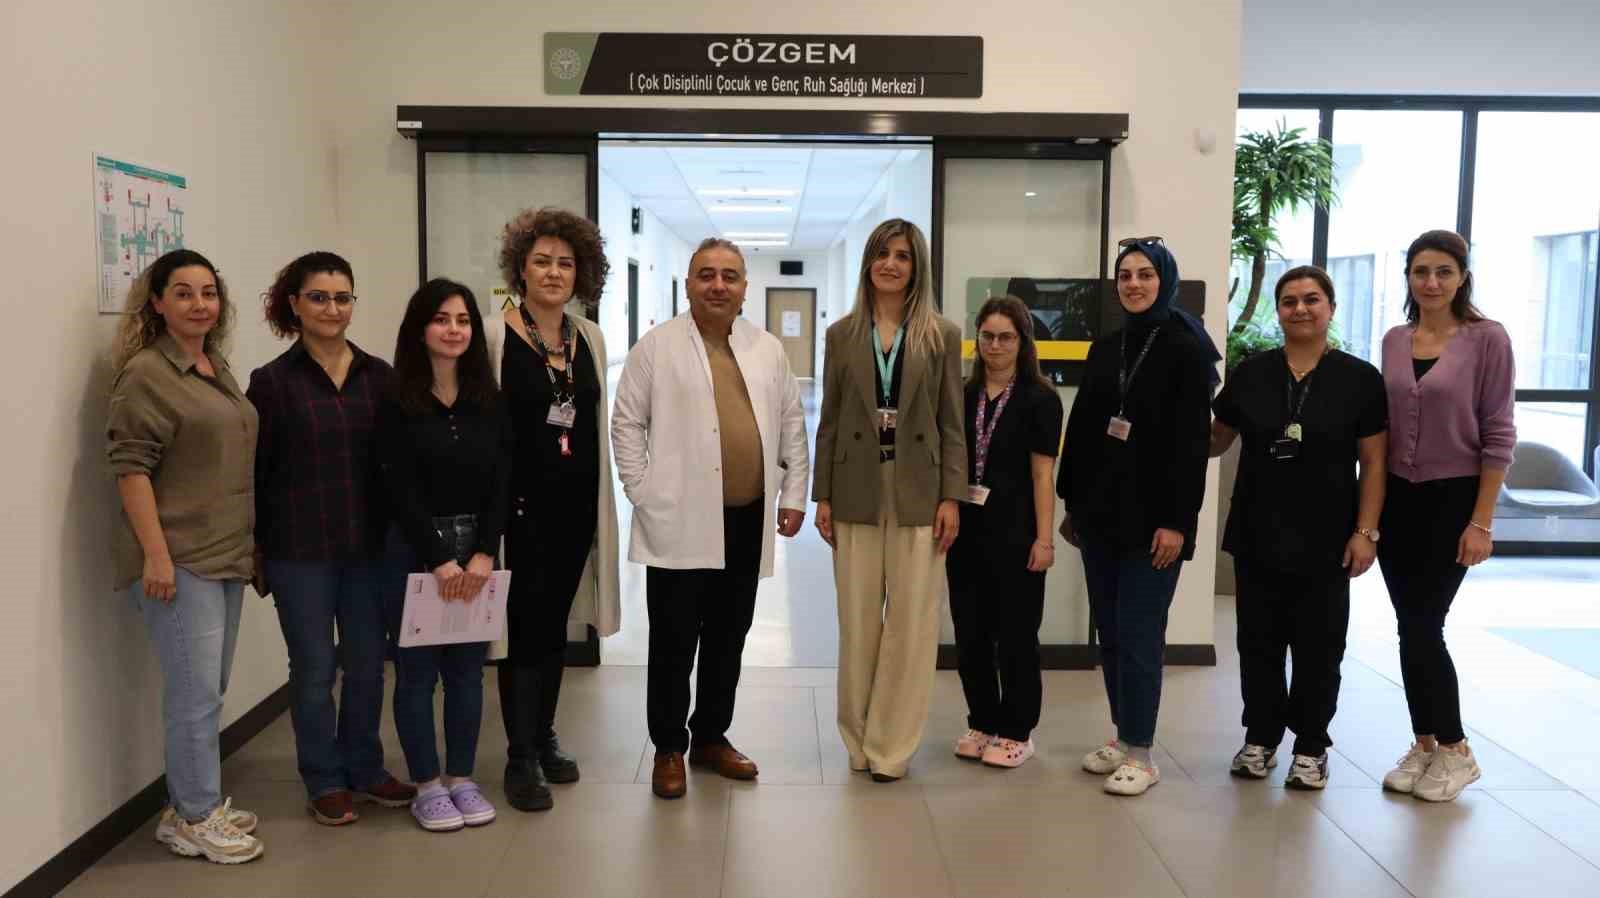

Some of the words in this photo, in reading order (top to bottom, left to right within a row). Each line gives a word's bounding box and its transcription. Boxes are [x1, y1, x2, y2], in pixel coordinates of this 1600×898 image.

[707, 38, 856, 67] ÇÖZGEM
[638, 74, 660, 94] Çok
[663, 74, 712, 94] Disiplinli
[716, 75, 751, 94] Çocuk
[755, 79, 767, 91] ve
[771, 75, 799, 95] Genç
[803, 76, 826, 93] Ruh
[829, 76, 868, 97] Sağlığı
[871, 77, 917, 95] Merkezi
